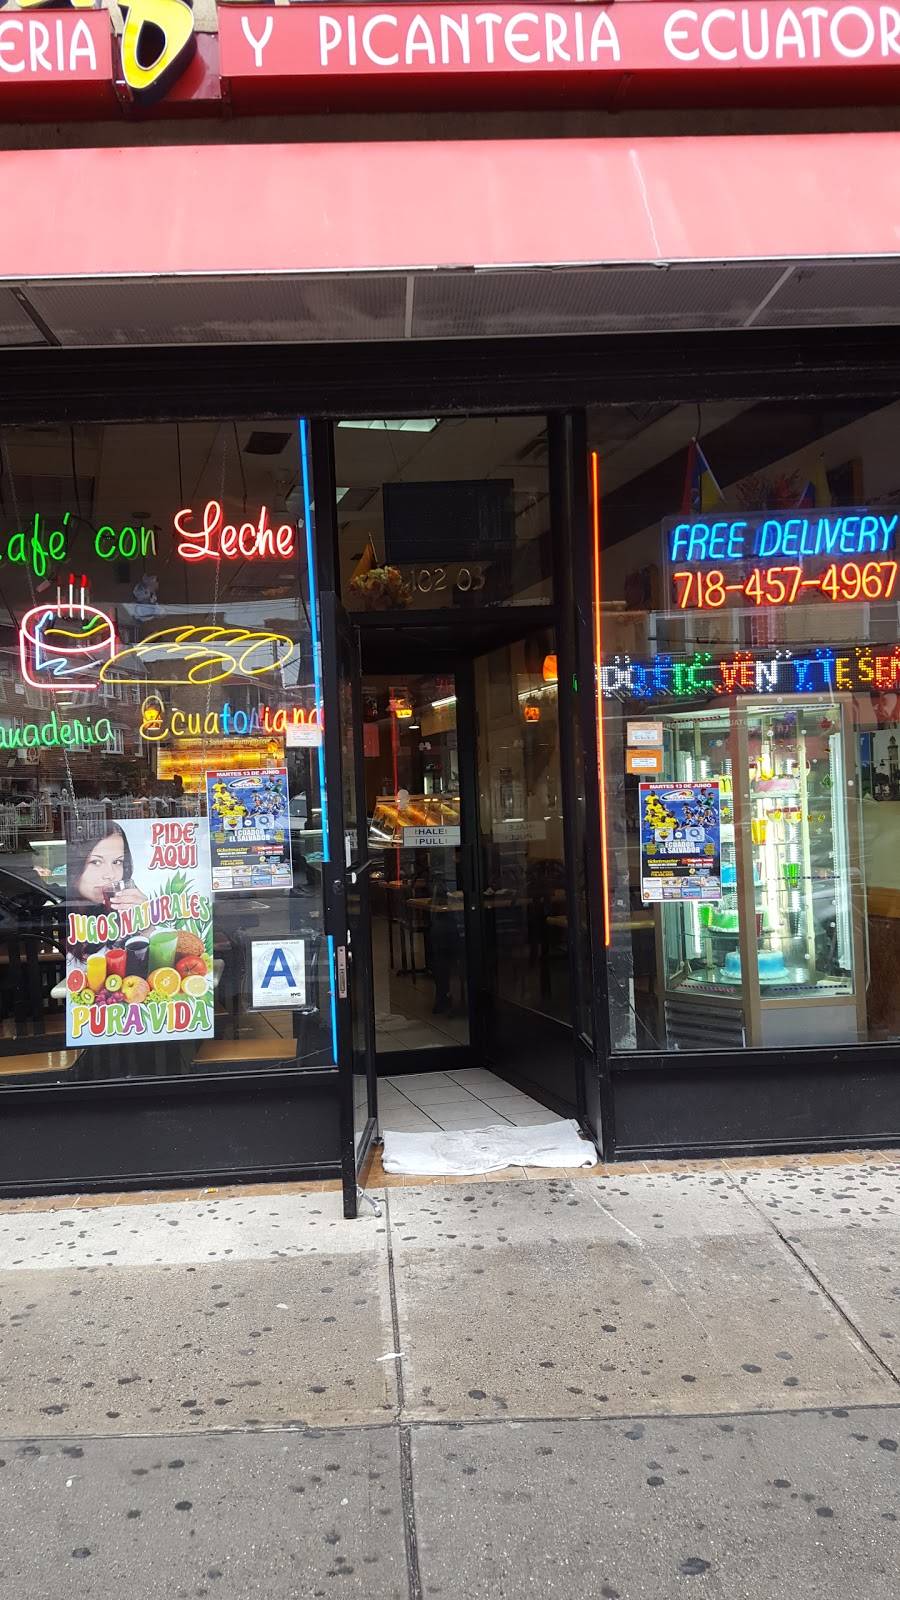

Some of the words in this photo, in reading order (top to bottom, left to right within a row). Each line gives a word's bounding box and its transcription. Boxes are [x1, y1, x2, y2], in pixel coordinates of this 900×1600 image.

[0, 18, 97, 73] ERIA
[241, 15, 273, 67] Y
[319, 11, 621, 67] PICANTERIA
[664, 6, 900, 61] ECUATOR
[0, 512, 71, 576] afé
[95, 526, 157, 559] con
[174, 500, 295, 558] Leche
[671, 521, 747, 561] FREE
[759, 515, 898, 557] DELIVERY
[673, 561, 897, 608] 718-457-4967
[720, 660, 778, 686] VEN
[151, 822, 195, 844] PIDE
[667, 846, 700, 854] SALVADOR
[68, 909, 120, 946] JUGOS
[118, 894, 211, 939] NATURALES
[260, 948, 297, 988] A
[70, 1001, 145, 1038] PURA
[148, 999, 212, 1033] VIDA
